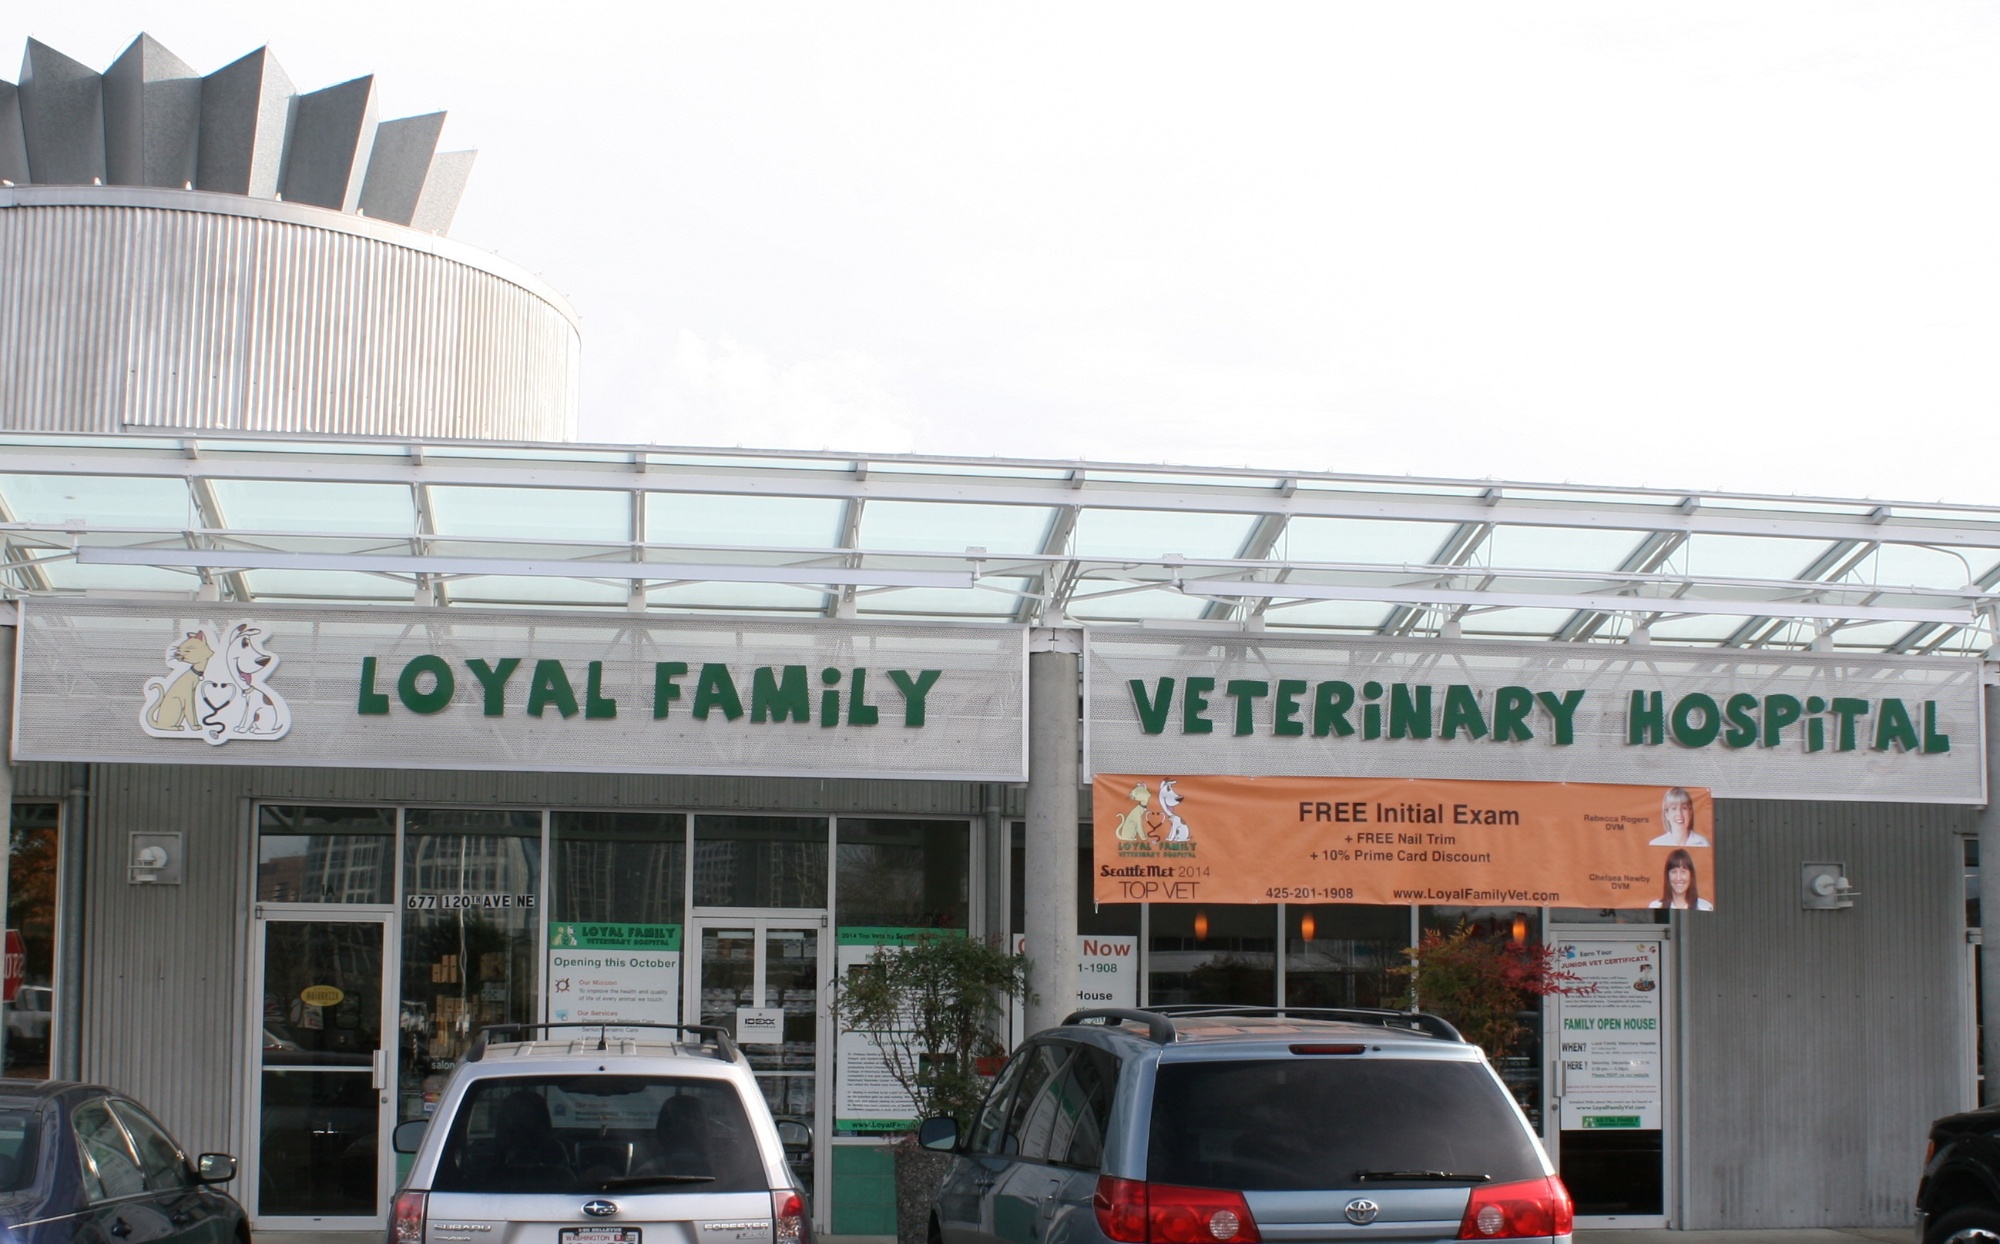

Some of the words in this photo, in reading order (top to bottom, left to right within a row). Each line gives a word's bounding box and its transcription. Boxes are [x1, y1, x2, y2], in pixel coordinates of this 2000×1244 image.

[358, 654, 617, 719] LOYAL
[1299, 802, 1367, 822] FREE
[1377, 803, 1443, 824] Initial
[1453, 804, 1519, 825] Exam
[1584, 814, 1618, 822] Rebecca
[1621, 815, 1649, 824] Rogers
[1605, 823, 1625, 831] DVM
[1357, 833, 1393, 844] FREE
[1398, 833, 1422, 844] Nail
[1427, 834, 1455, 845] Trim
[1118, 842, 1151, 851] LOYAL
[1322, 850, 1350, 861] 10%
[1354, 850, 1393, 862] Prime
[1397, 850, 1427, 862] Card
[1432, 851, 1491, 863] Discount
[1178, 866, 1210, 877] 2014
[1589, 873, 1622, 881] Chelsea
[1624, 874, 1650, 883] Newby
[1118, 881, 1159, 899] TOP
[1163, 881, 1200, 899] VET
[1265, 887, 1353, 899] 425-201-1908
[1393, 887, 1560, 902] www.LoyalFamilyVet.com
[409, 896, 435, 908] 677
[484, 896, 510, 907] AVE
[517, 896, 535, 907] NE
[582, 926, 624, 937] LOYAL
[628, 927, 675, 938] FAMILY
[1083, 940, 1131, 956] Now
[554, 957, 601, 969] Opening
[605, 957, 626, 967] this
[629, 958, 676, 968] October
[1077, 963, 1118, 973] 1-1908
[1561, 961, 1588, 969] JUNIOR
[1604, 955, 1649, 965] CERTIFICATE
[1564, 1018, 1595, 1030] FAMILY
[1597, 1018, 1621, 1030] OPEN
[1624, 1018, 1656, 1030] HOUSE!
[1562, 1042, 1587, 1052] WHEN?
[432, 1060, 455, 1070] salon
[433, 1223, 492, 1232] SUBARU
[704, 1222, 769, 1231] FORESTER
